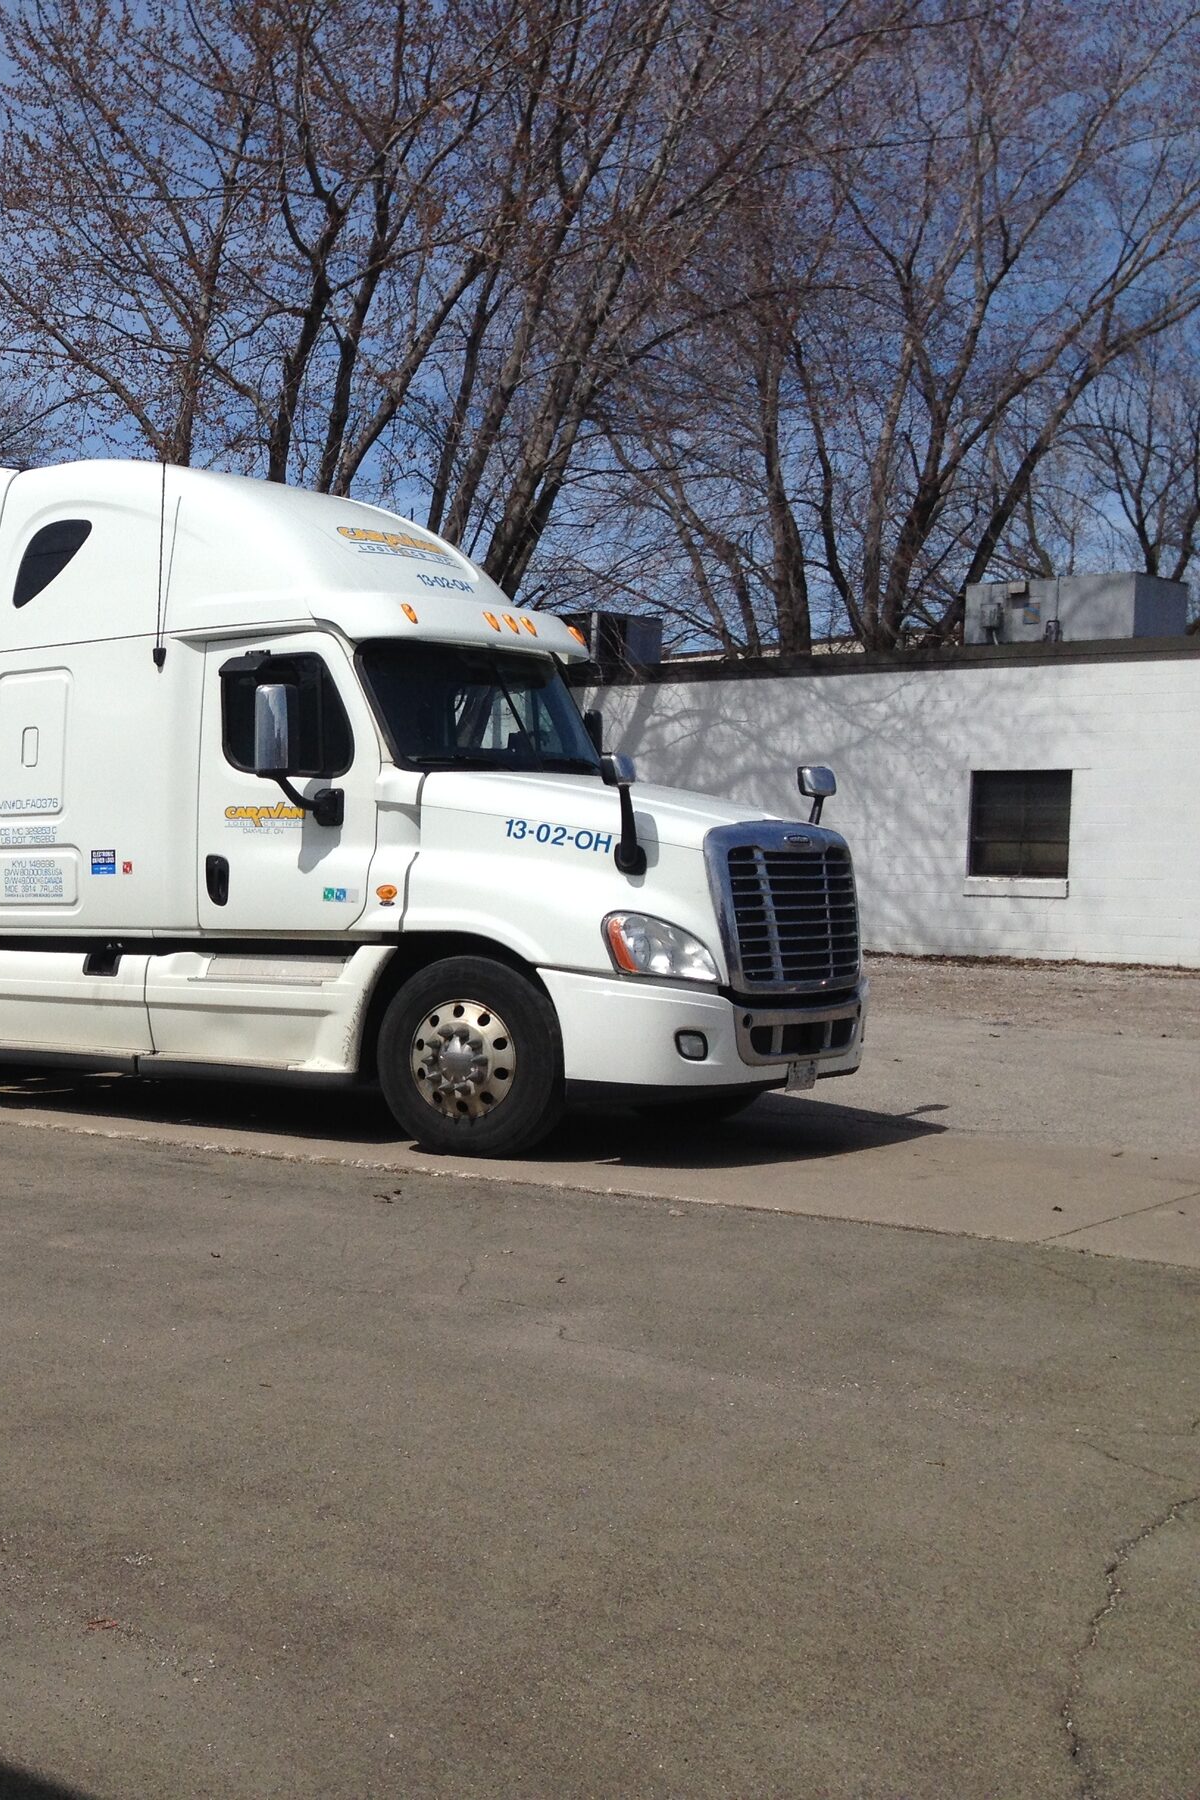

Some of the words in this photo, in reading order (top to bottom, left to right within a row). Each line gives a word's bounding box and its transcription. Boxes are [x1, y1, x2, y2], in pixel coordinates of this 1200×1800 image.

[417, 573, 475, 594] 13-02-OH
[224, 801, 305, 827] CARAVAN
[505, 819, 612, 854] 13-02-OH
